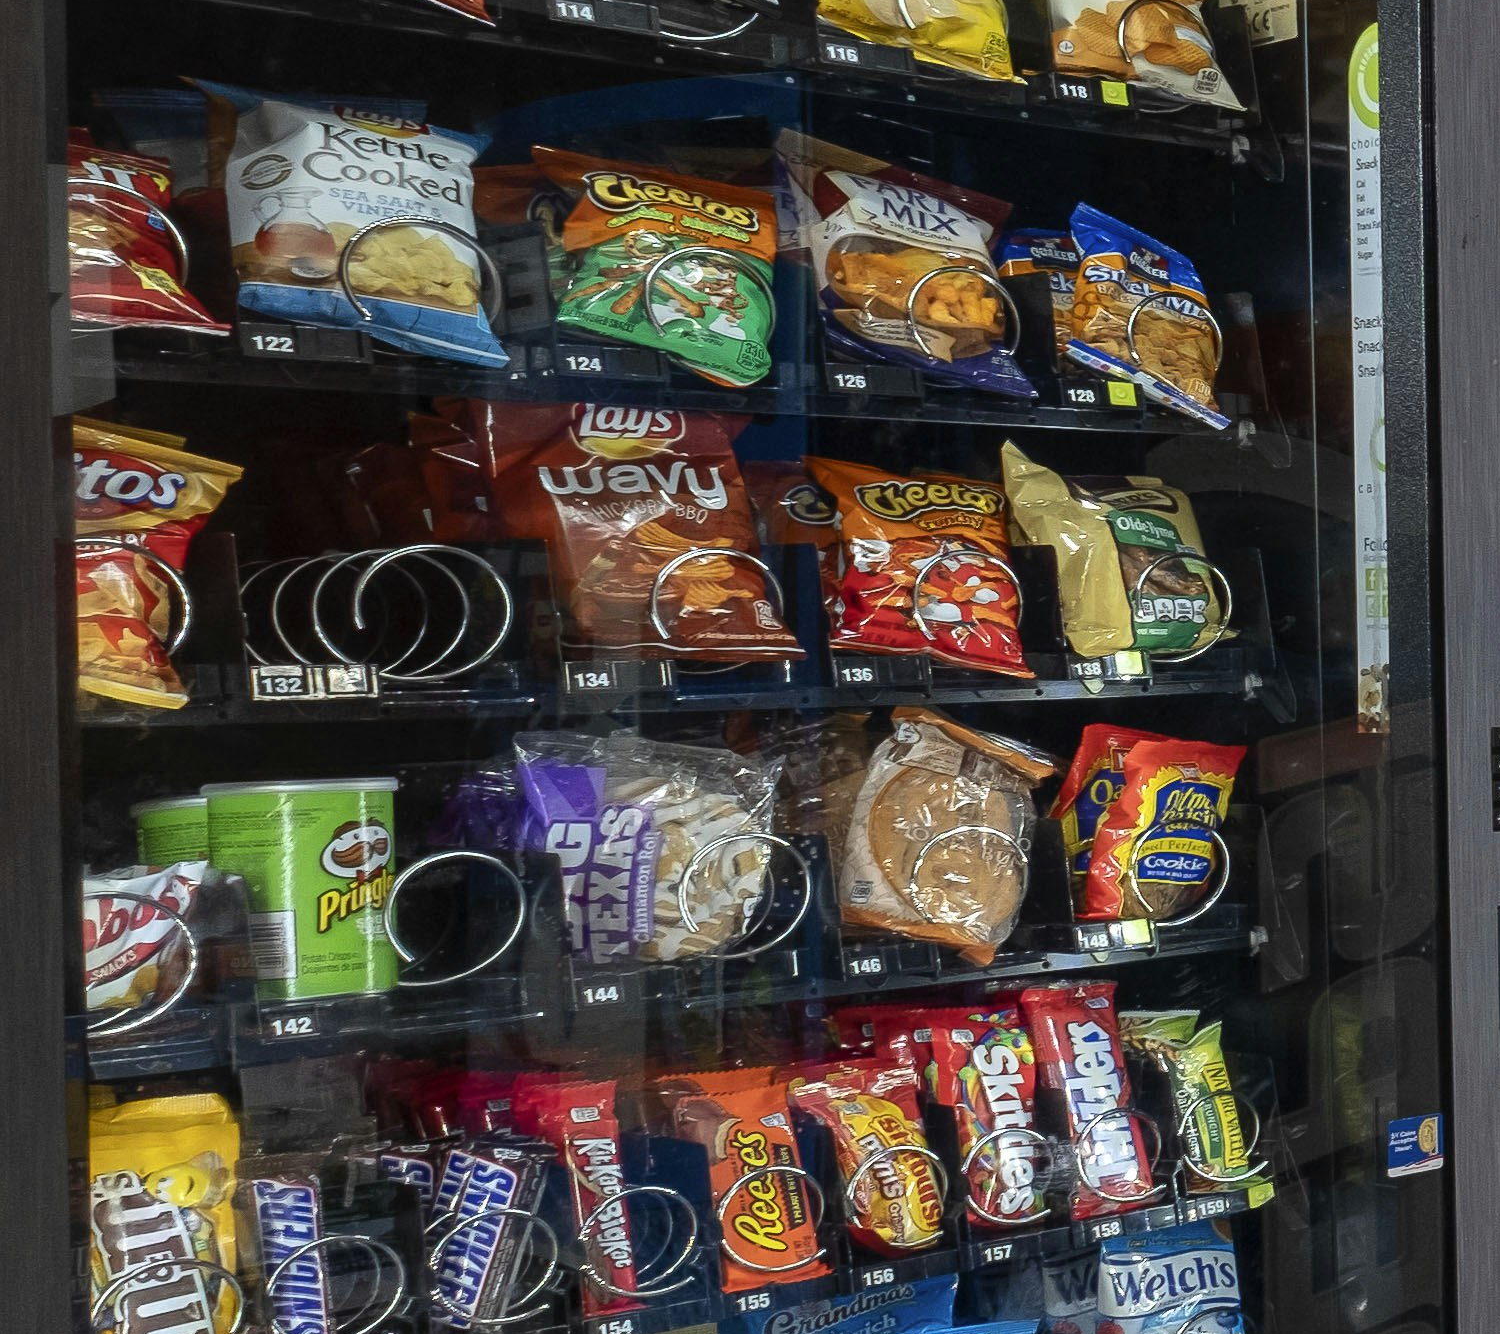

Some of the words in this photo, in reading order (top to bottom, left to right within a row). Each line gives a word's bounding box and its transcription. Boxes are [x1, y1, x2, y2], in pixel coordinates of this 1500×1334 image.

[555, 1, 593, 21] 114
[826, 45, 859, 64] 116
[1060, 83, 1088, 100] 118
[319, 122, 454, 170] Kettle
[302, 151, 465, 207] Cooked
[329, 186, 372, 203] SEA
[376, 192, 422, 212] SALT
[590, 173, 758, 230] Cheetos
[881, 198, 962, 237] MIX
[251, 333, 295, 353] 122
[566, 355, 602, 372] 124
[834, 374, 867, 390] 126
[1067, 387, 1095, 404] 128
[537, 461, 729, 512] wavy
[858, 482, 1003, 519] Cheetos
[674, 503, 708, 525] BBQ
[914, 513, 985, 531] Crunchy
[573, 672, 610, 688] 134
[841, 666, 873, 683] 136
[260, 675, 302, 694] 132
[1143, 854, 1208, 873] Cookie
[590, 805, 645, 965] TEXAS
[317, 868, 396, 936] Pringl
[1081, 933, 1109, 949] 148
[849, 958, 882, 975] 146
[583, 987, 619, 1003] 144
[271, 1016, 312, 1035] 142
[973, 1043, 1035, 1217] Skittles
[1199, 1199, 1225, 1215] 159
[1092, 1222, 1121, 1238] 158
[983, 1245, 1013, 1261] 157
[863, 1268, 894, 1286] 156
[1107, 1258, 1237, 1307] Welch's
[736, 1294, 771, 1313] 155
